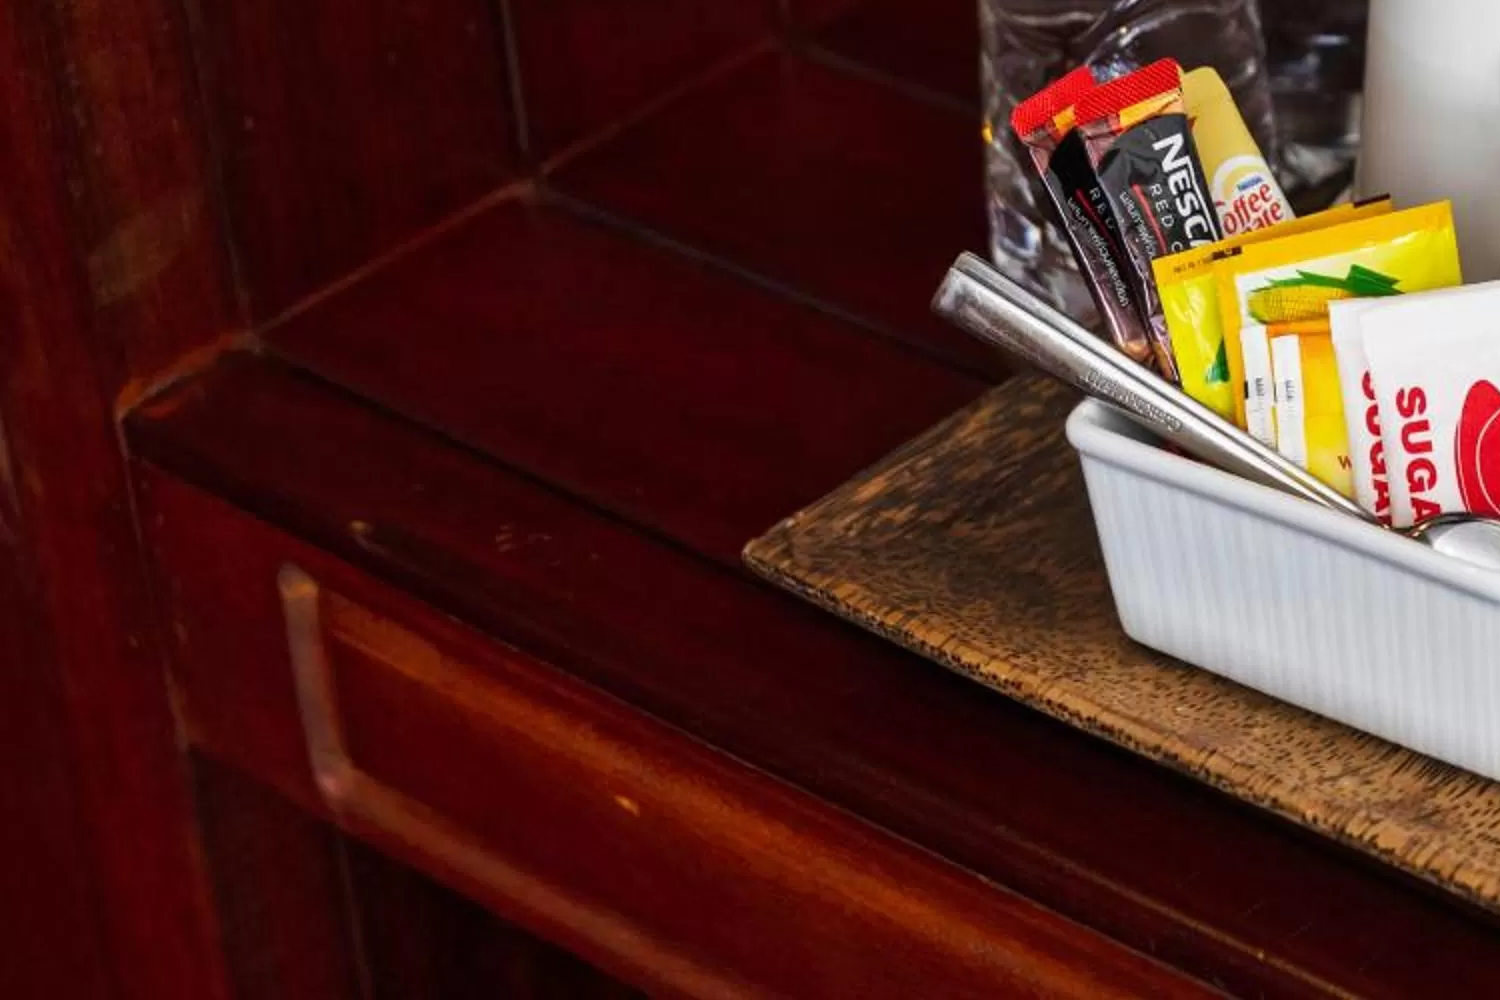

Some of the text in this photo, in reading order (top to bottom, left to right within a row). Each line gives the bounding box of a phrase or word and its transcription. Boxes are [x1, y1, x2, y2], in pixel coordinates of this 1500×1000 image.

[1150, 183, 1175, 228] RED
[1216, 184, 1273, 234] offee
[1244, 202, 1284, 232] ate
[1395, 386, 1442, 526] SUGA
